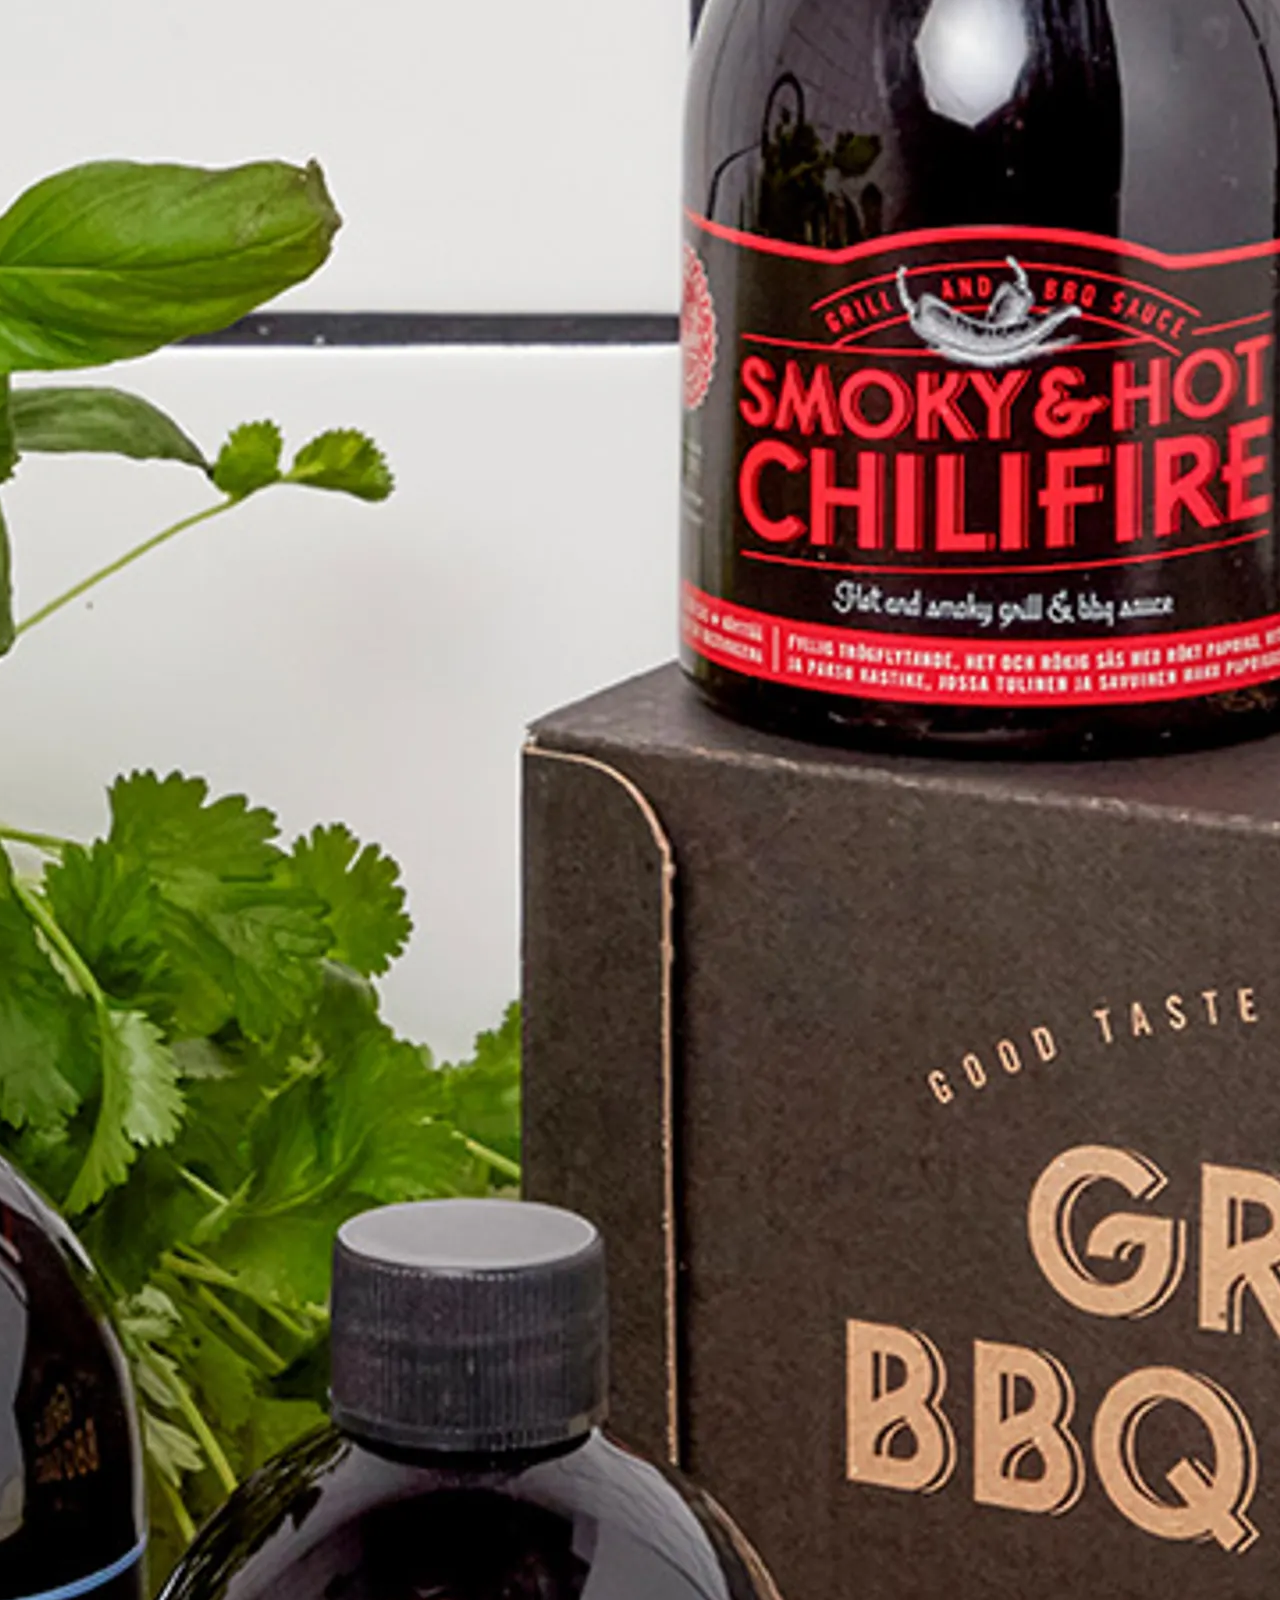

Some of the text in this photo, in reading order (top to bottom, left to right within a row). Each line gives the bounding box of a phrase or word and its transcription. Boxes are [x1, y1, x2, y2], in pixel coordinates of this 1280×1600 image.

[825, 275, 1186, 339] GRILL AND BBQ SAUCE
[739, 416, 1273, 552] CHILIFIRE
[925, 593, 993, 626] smoky
[999, 593, 1042, 630] grill
[1047, 589, 1074, 623] &
[1078, 593, 1114, 627] bbq
[928, 986, 1259, 1104] GOOD TASTE
[845, 1318, 1260, 1553] BBQ
